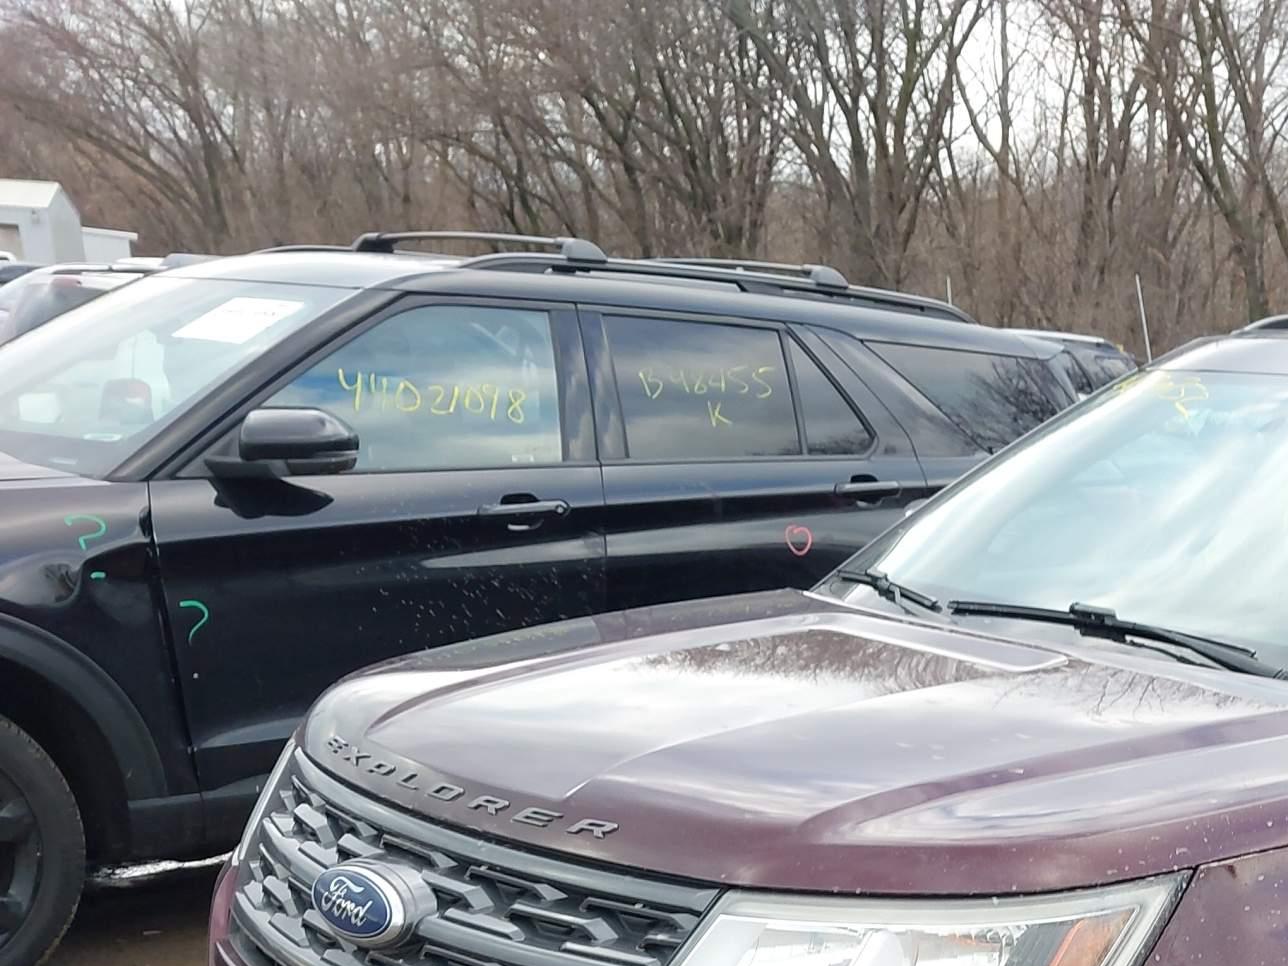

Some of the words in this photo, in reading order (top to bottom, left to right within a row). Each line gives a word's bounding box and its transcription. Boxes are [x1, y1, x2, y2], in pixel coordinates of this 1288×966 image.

[707, 401, 733, 427] K
[327, 734, 619, 838] EXPLORER
[321, 875, 375, 928] Ford
